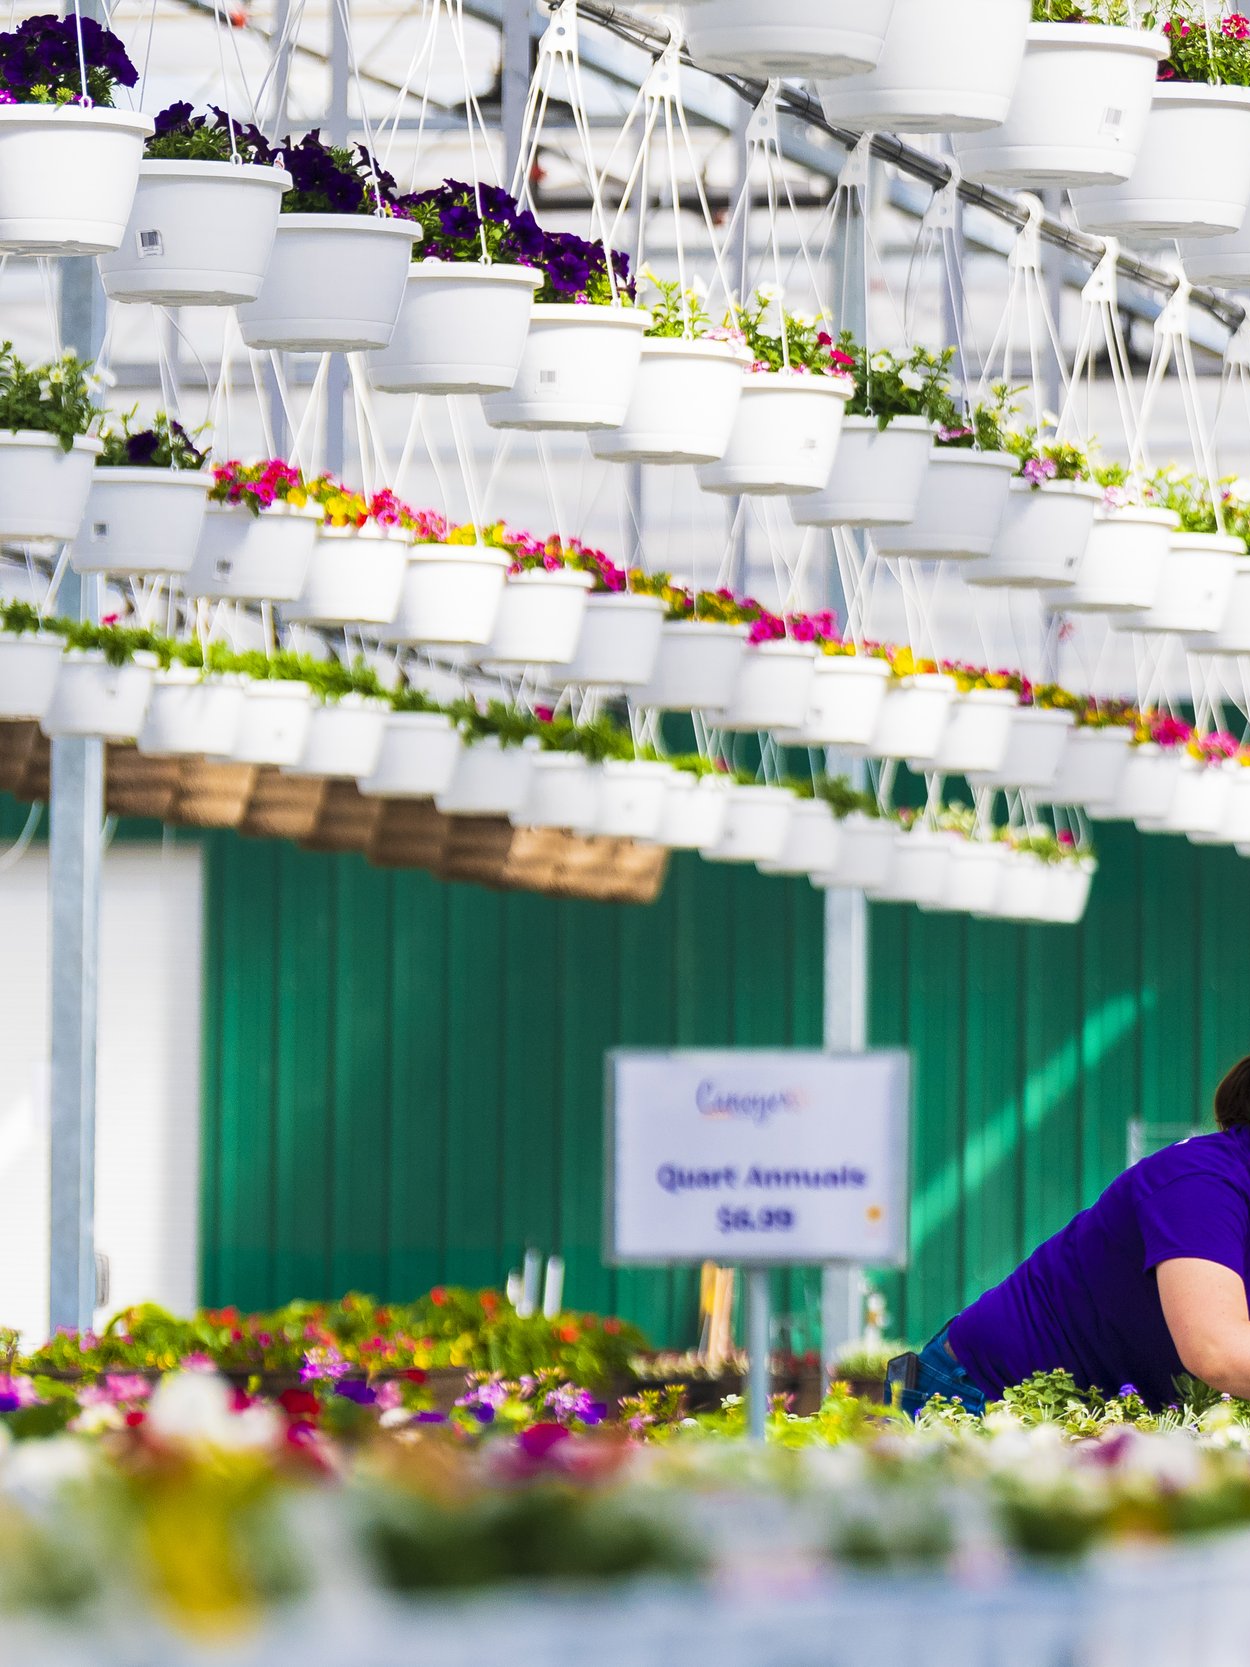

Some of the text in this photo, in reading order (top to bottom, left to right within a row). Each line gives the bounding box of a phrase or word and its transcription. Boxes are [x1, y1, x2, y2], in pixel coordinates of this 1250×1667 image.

[656, 1161, 868, 1194] Quart Annuals
[716, 1204, 796, 1234] $6.99
